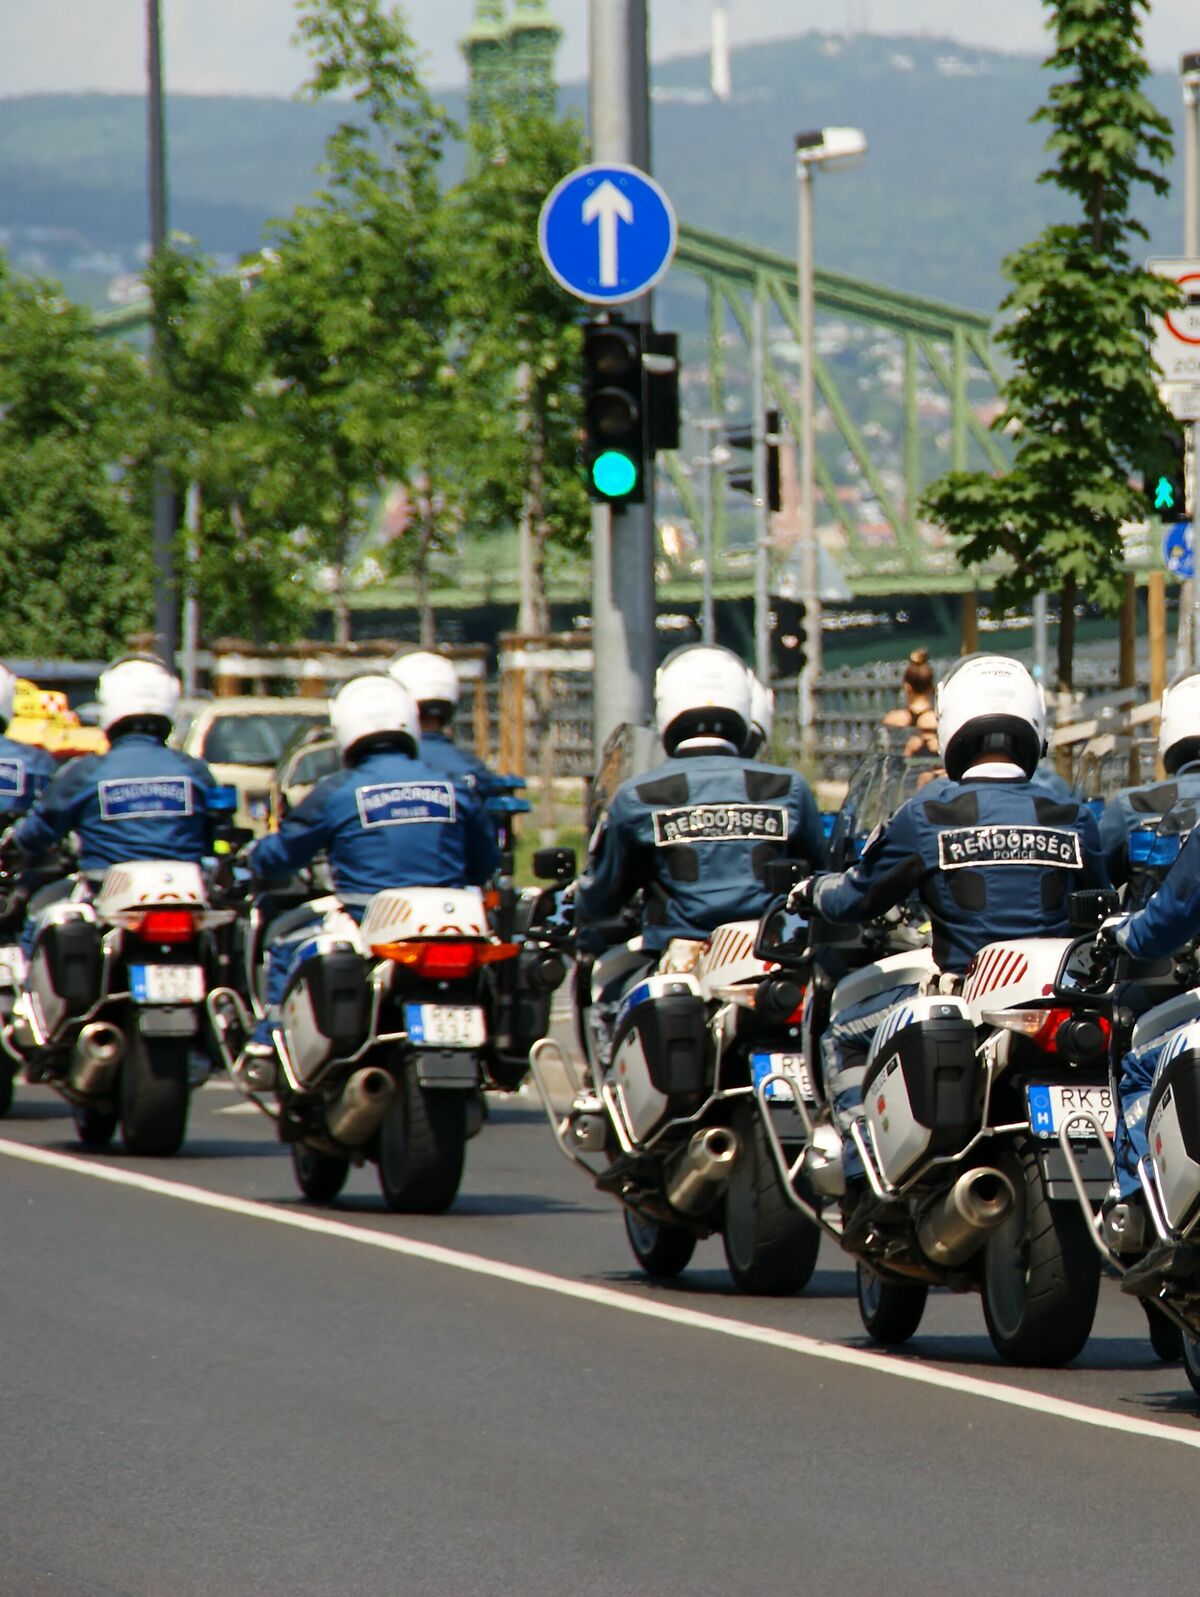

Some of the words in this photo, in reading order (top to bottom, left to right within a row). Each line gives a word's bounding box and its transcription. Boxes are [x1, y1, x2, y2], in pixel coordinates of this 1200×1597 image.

[950, 829, 1073, 860] RENDŐRSÉG
[993, 850, 1036, 860] POLICE
[1061, 1089, 1094, 1108] RK
[1100, 1089, 1112, 1108] 8
[1037, 1112, 1049, 1125] H
